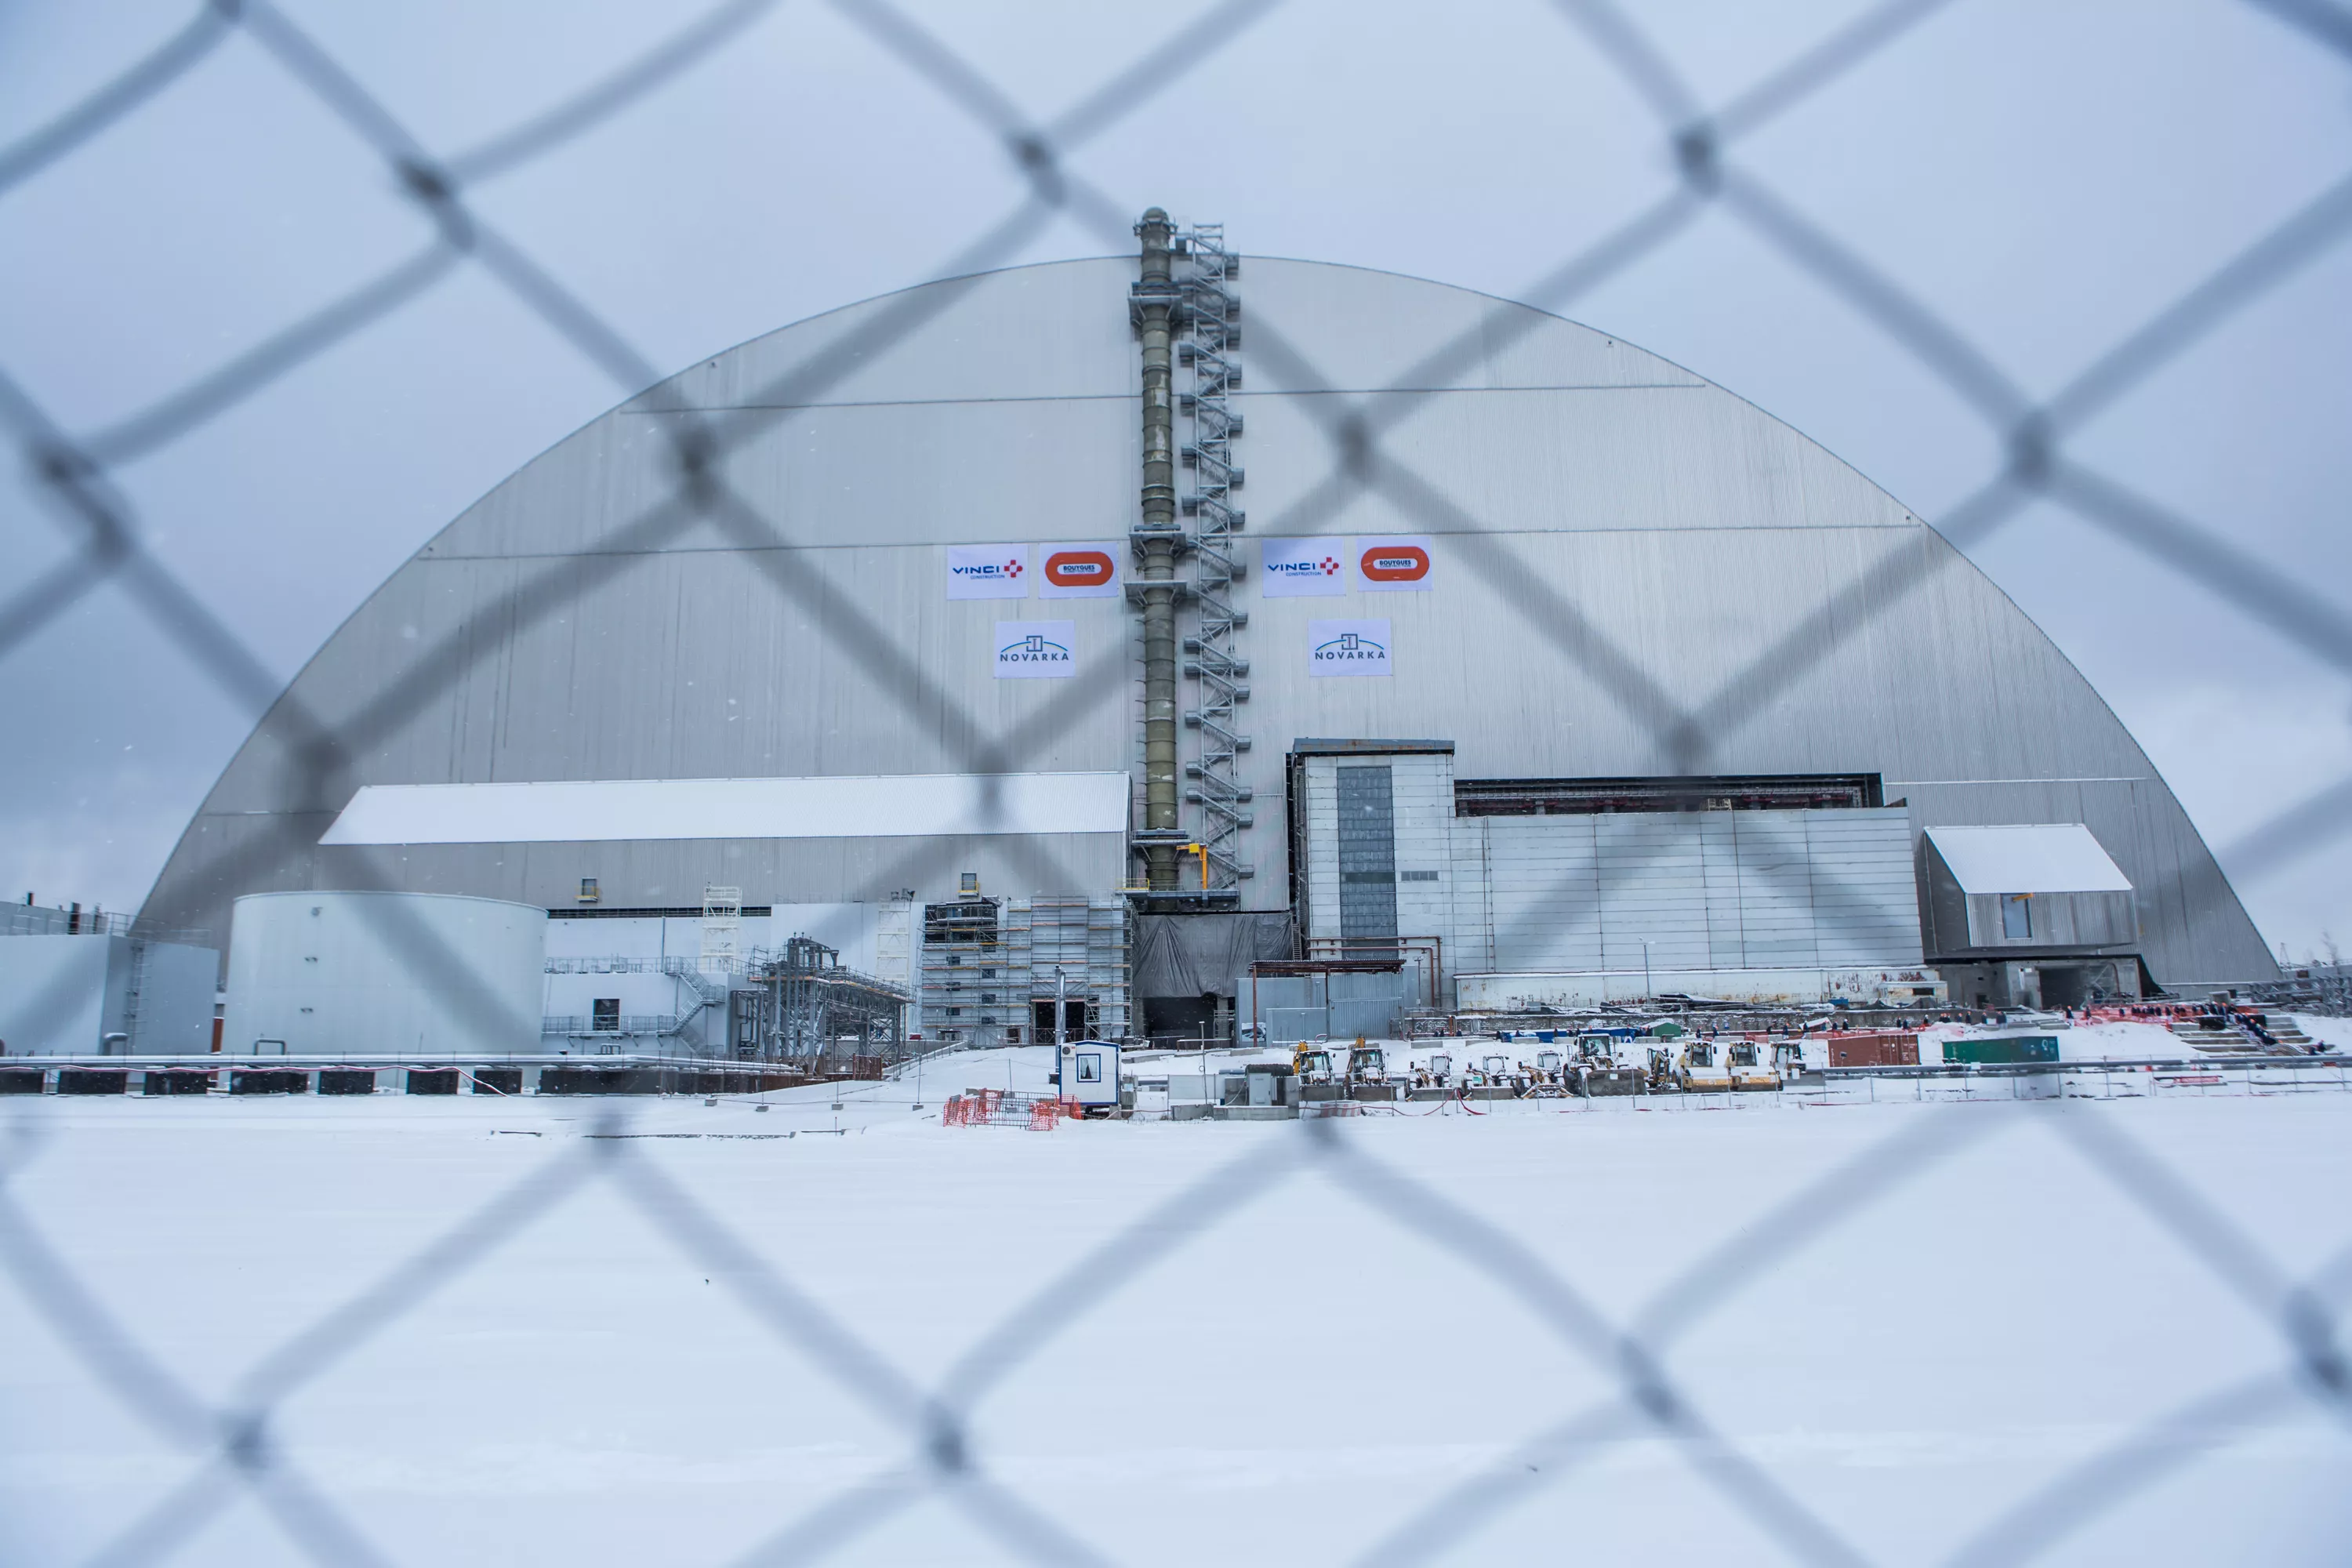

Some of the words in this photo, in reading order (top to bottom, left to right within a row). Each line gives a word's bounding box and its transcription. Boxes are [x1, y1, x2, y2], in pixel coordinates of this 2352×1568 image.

[953, 565, 1000, 574] VINCI
[1268, 563, 1315, 572] VINCI
[1000, 653, 1069, 662] NOVARKA
[1315, 651, 1385, 660] NOVARKA
